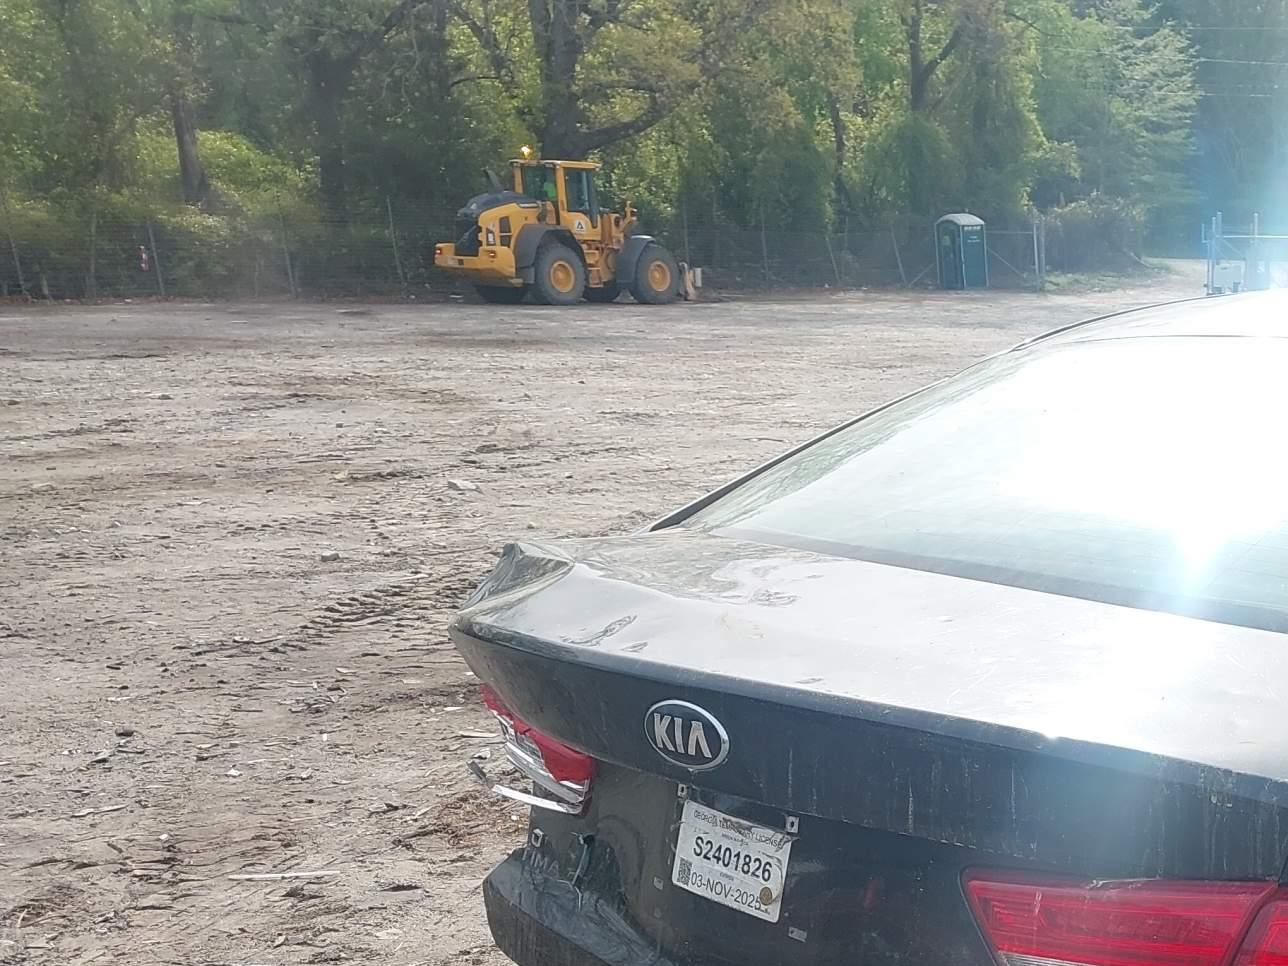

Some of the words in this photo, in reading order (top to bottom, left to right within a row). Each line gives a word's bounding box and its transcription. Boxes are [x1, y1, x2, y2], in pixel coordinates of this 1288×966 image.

[653, 712, 713, 759] KIA
[693, 836, 773, 882] S2401826
[690, 871, 763, 911] 03-NOV-2025
